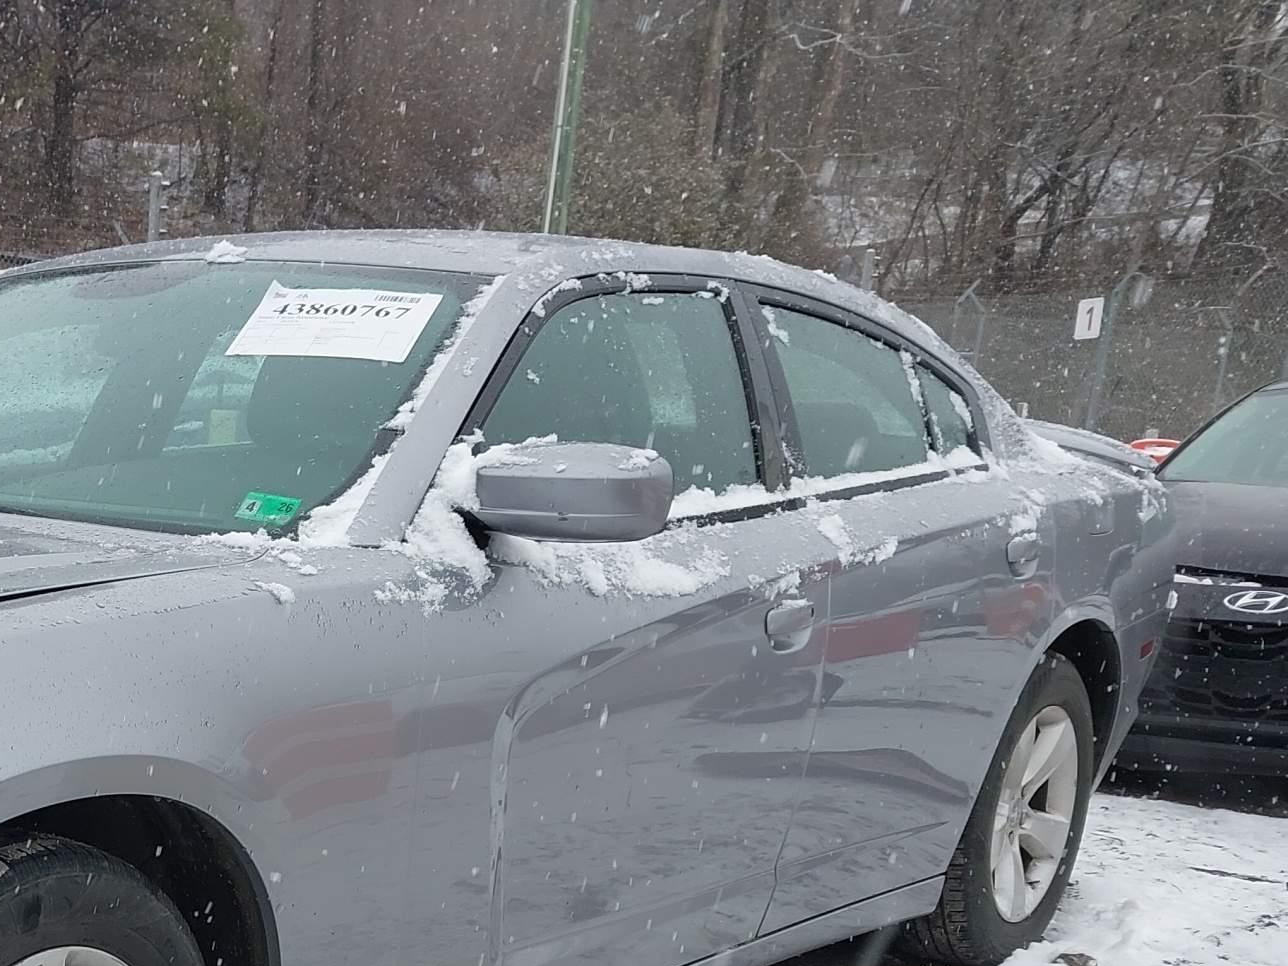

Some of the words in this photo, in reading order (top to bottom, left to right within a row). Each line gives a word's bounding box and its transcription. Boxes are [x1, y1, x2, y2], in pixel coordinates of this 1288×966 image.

[273, 303, 414, 319] 43860767
[1086, 306, 1095, 331] 1
[245, 501, 257, 513] 4
[278, 502, 294, 513] 26
